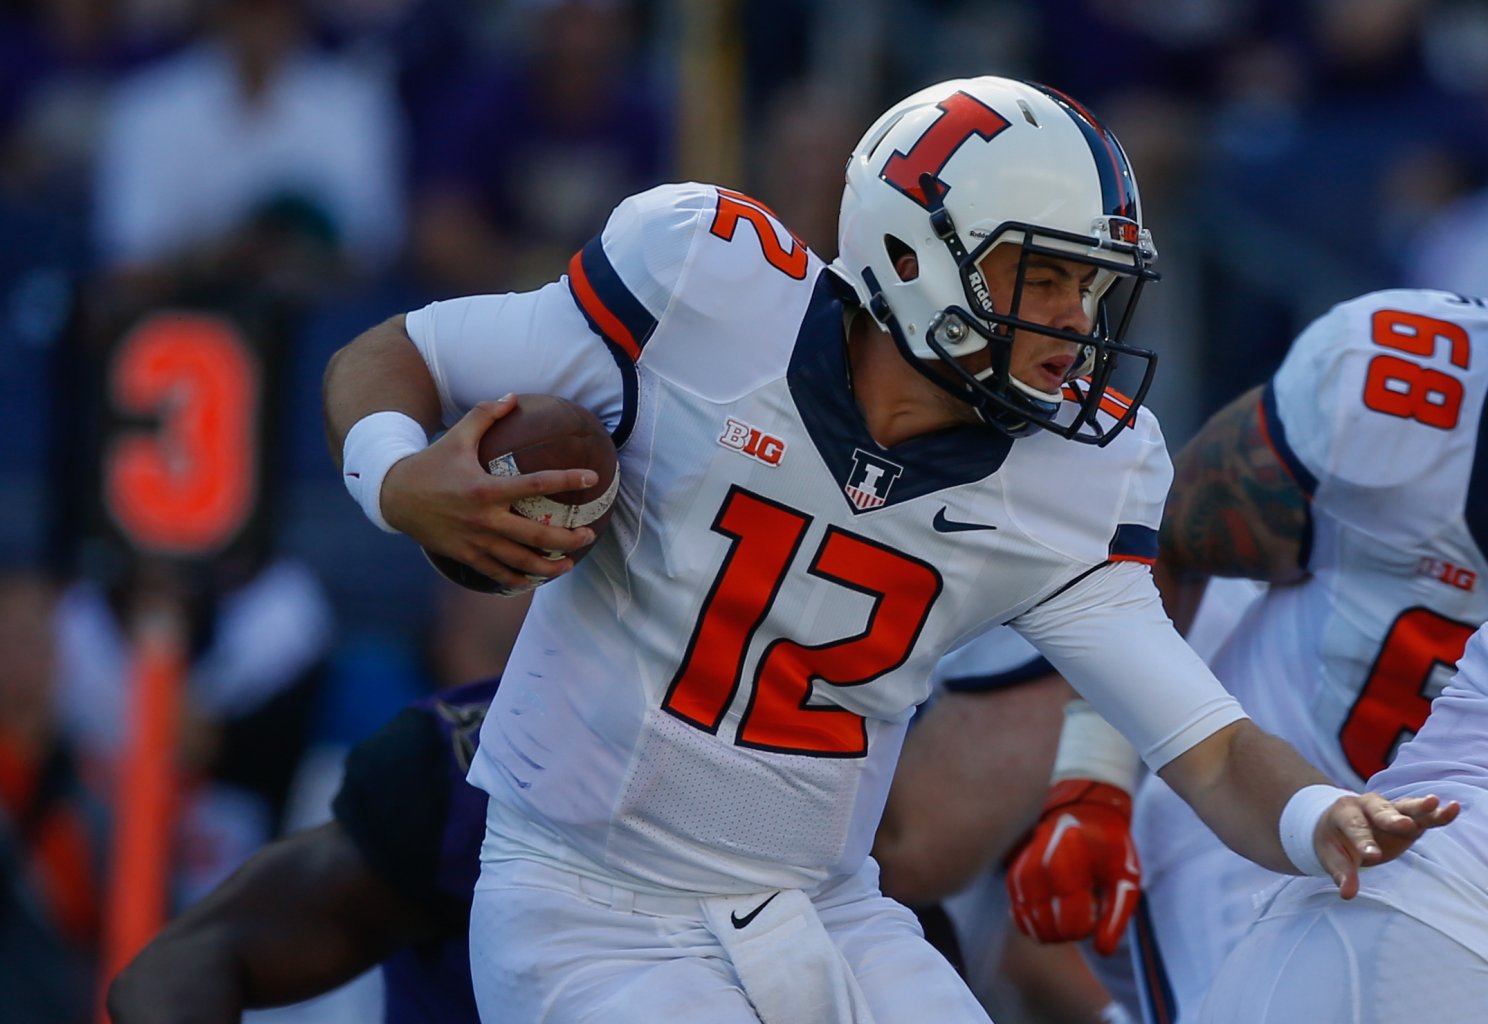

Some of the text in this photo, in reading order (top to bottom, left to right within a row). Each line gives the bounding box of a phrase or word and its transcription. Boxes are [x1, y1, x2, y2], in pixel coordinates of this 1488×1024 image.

[880, 90, 1011, 211] I
[105, 312, 262, 553] 3
[1363, 309, 1472, 431] 68
[662, 483, 943, 759] 12
